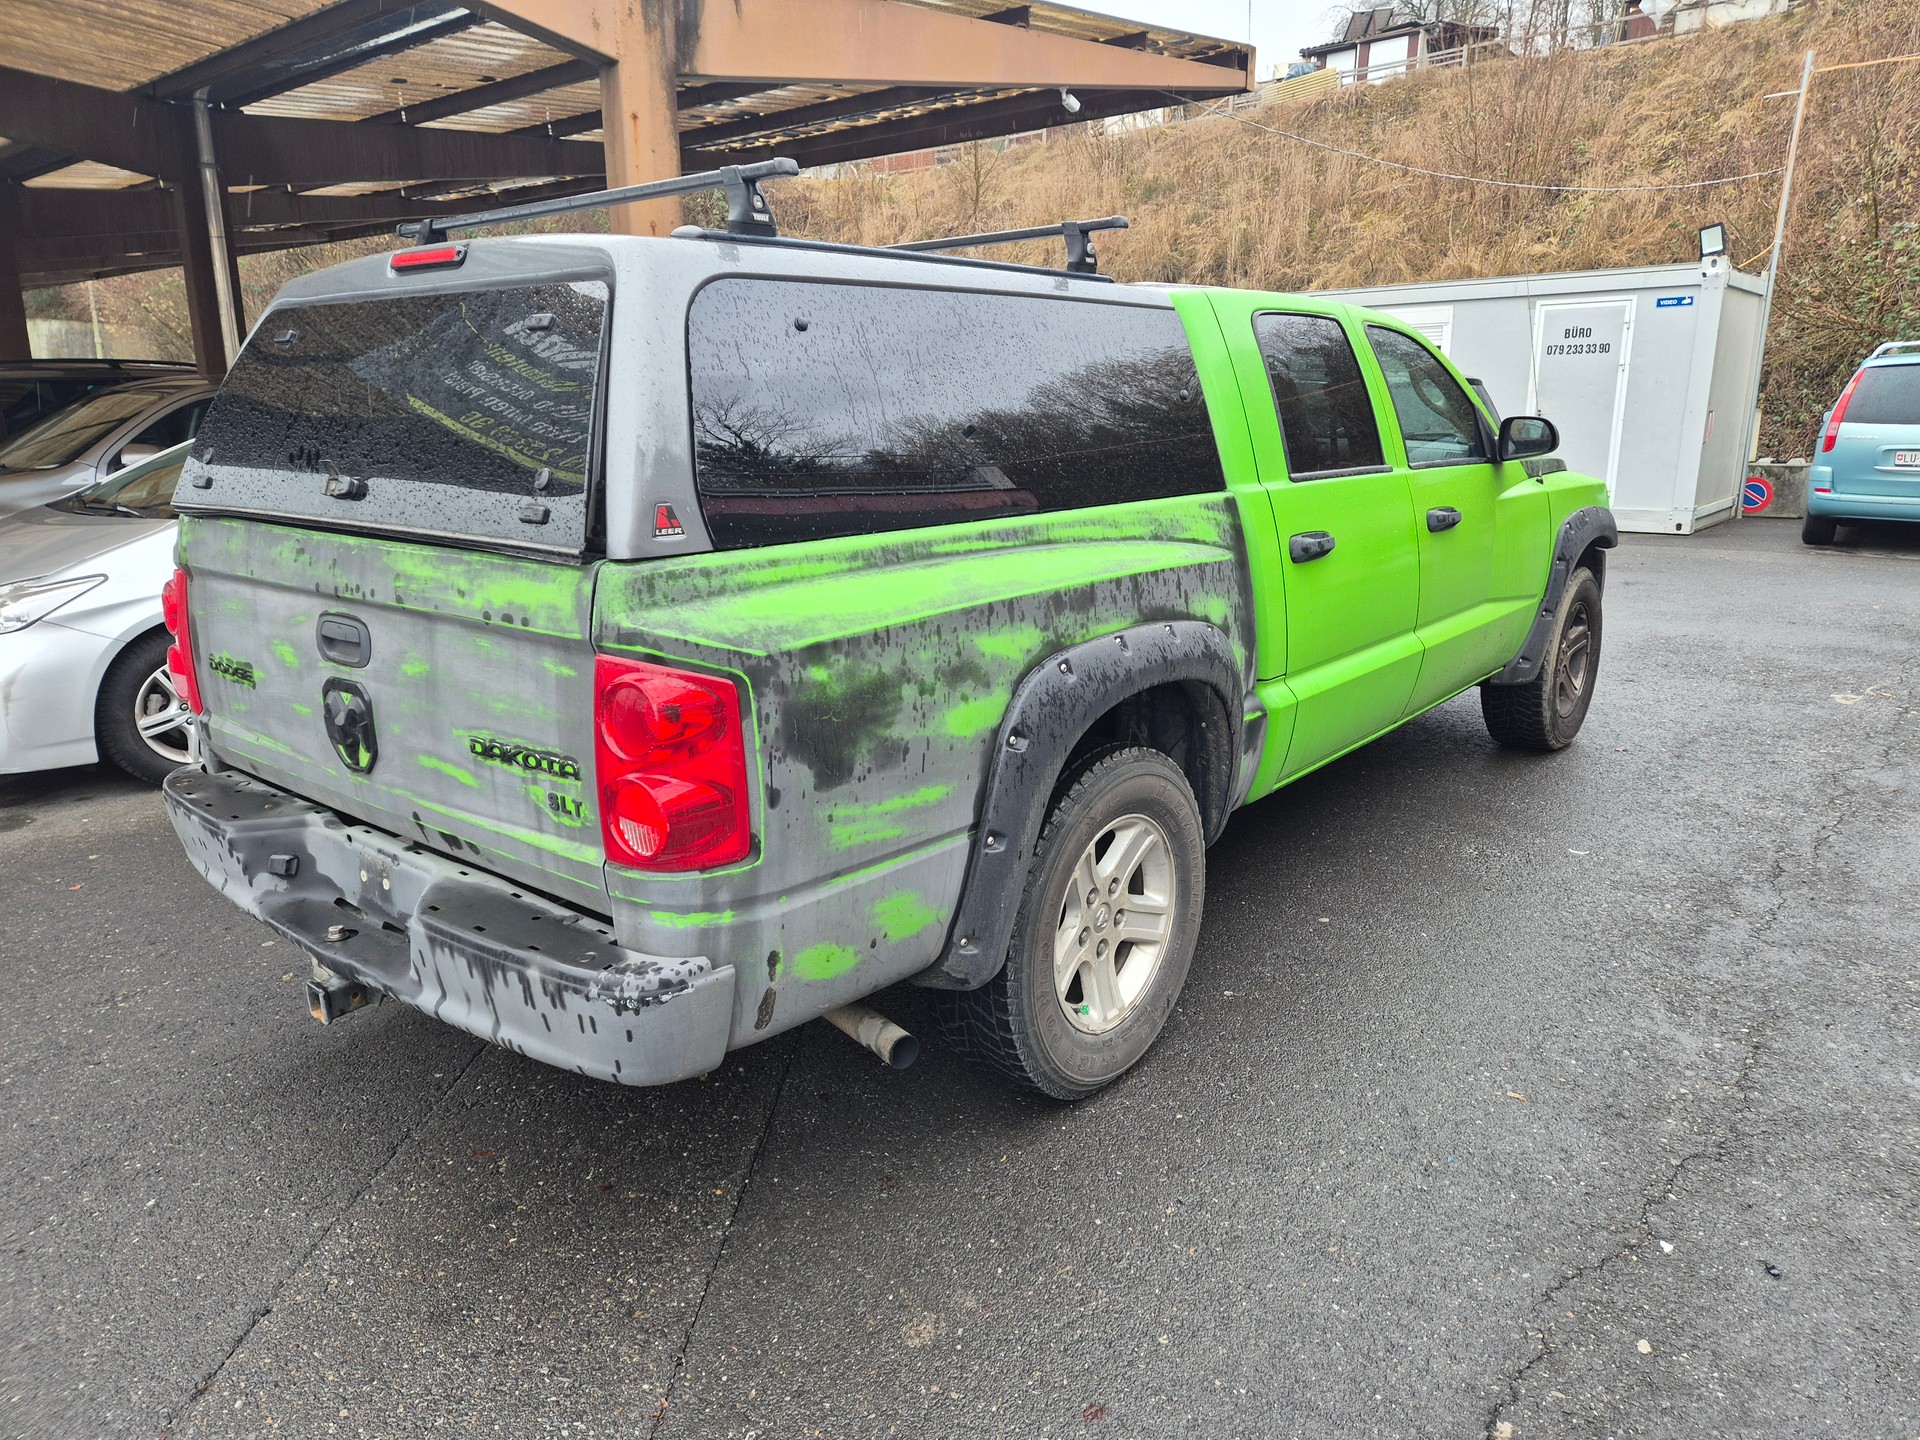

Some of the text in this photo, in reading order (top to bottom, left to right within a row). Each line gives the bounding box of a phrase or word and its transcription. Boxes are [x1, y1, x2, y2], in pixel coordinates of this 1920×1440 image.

[1564, 326, 1592, 339] BÜRO
[1546, 343, 1611, 356] 079 233 33 90
[655, 527, 683, 536] LEER
[208, 657, 254, 683] DODGE
[469, 736, 581, 781] DAKOTA
[547, 792, 583, 818] SLT
